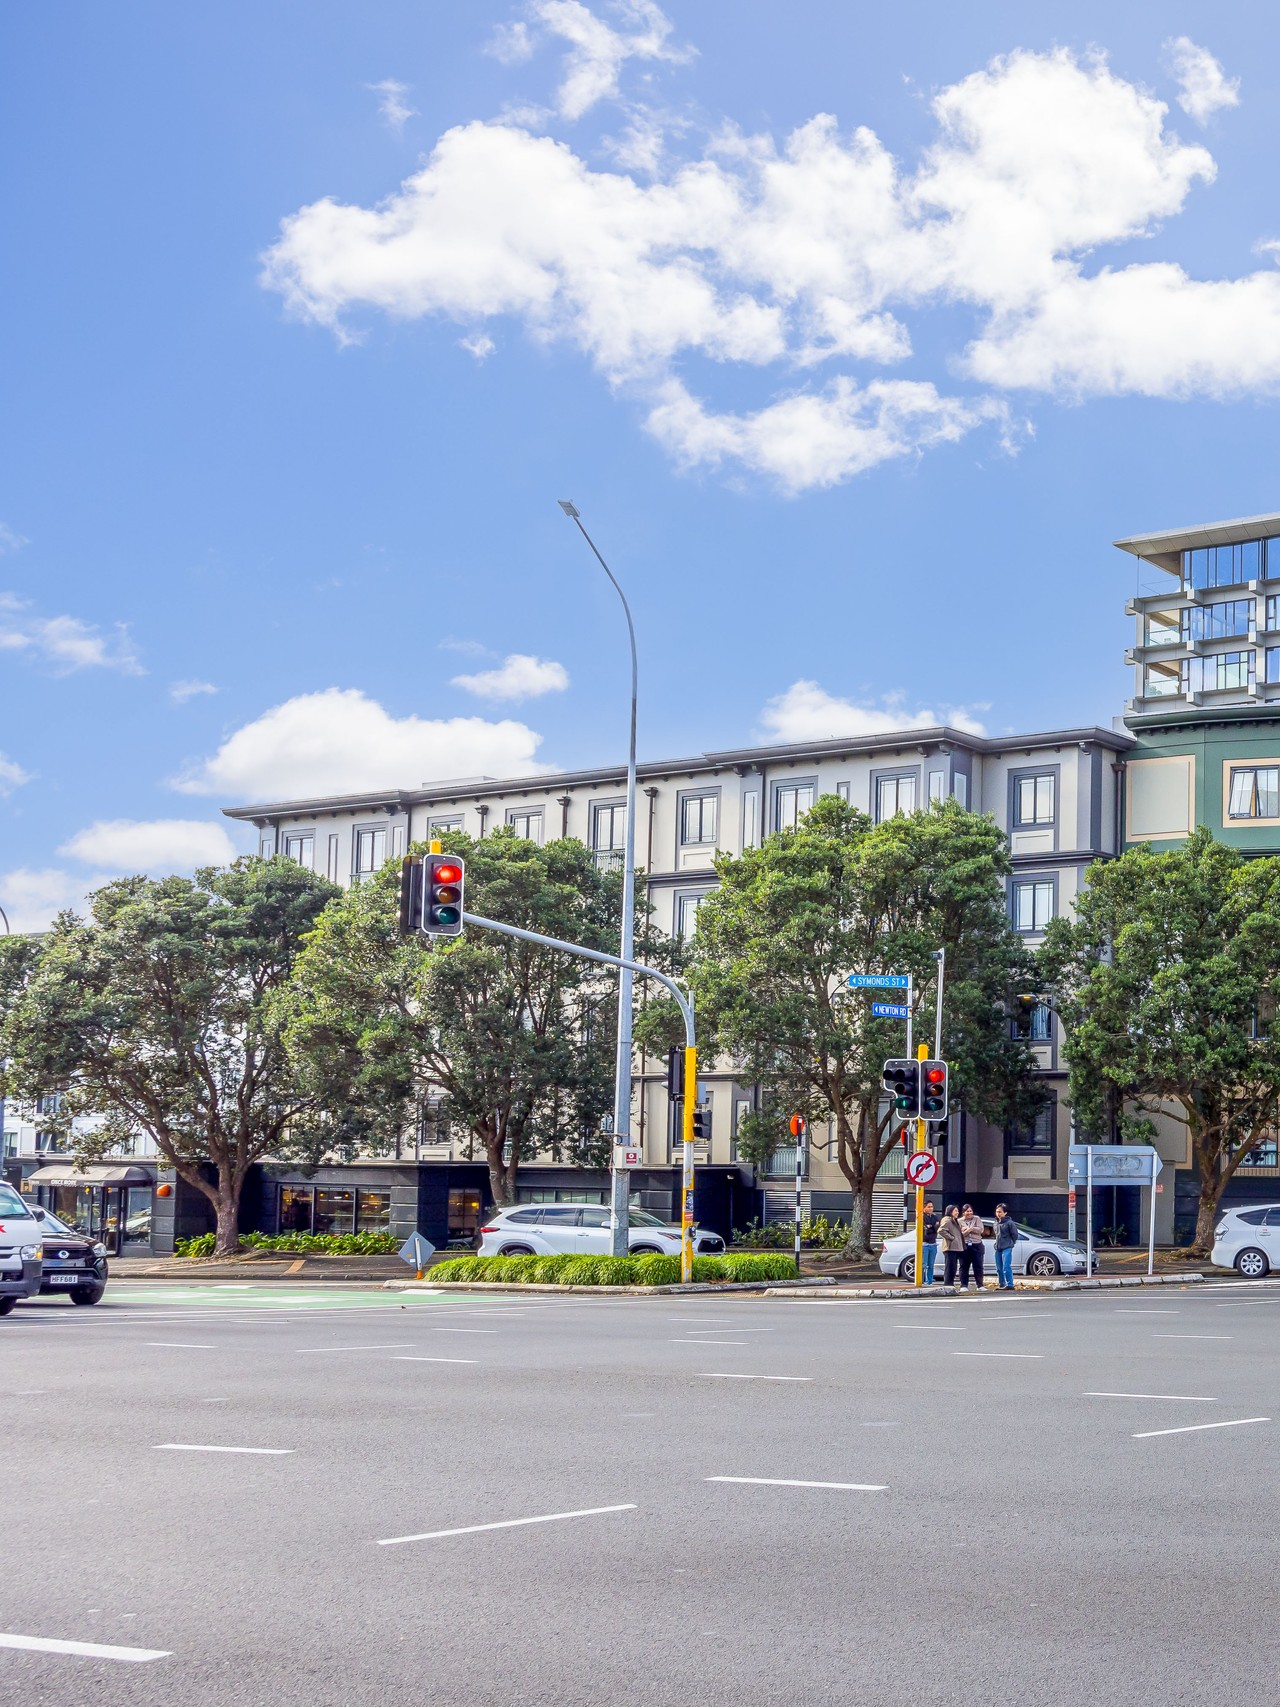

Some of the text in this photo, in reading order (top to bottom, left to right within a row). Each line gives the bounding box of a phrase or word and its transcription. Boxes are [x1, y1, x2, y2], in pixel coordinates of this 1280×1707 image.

[857, 977, 900, 986] SYMONDS ST
[878, 1005, 907, 1017] NEWTON RD
